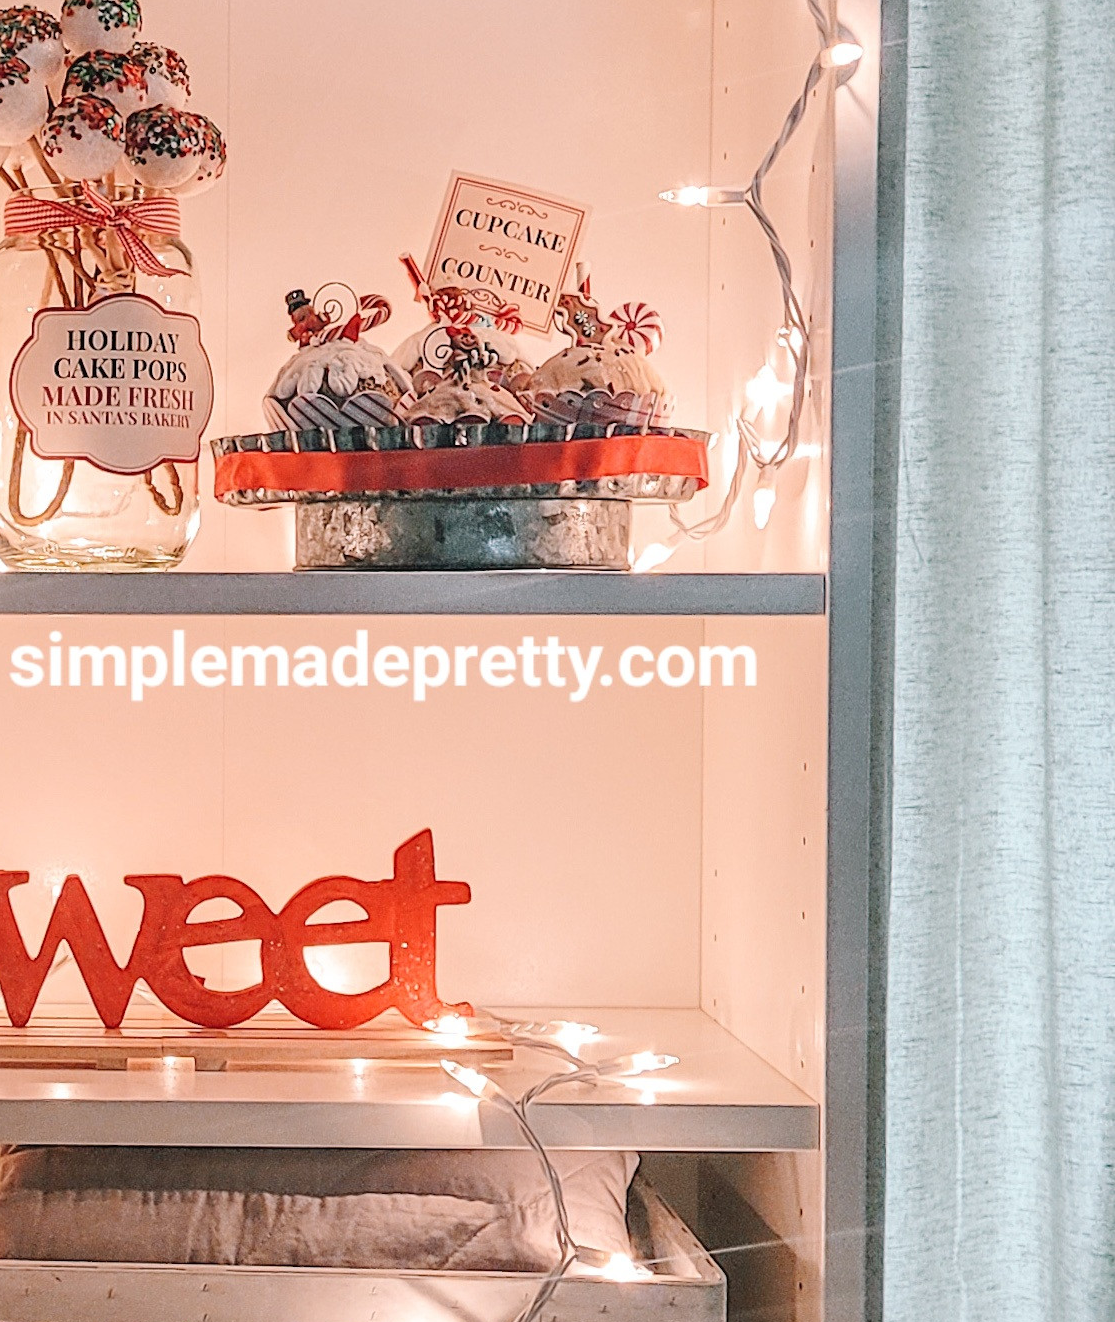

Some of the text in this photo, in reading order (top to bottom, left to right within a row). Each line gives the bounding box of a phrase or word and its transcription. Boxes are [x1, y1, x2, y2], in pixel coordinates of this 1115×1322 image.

[456, 209, 566, 253] CUPCAKE
[441, 257, 551, 303] COUNTER
[67, 330, 179, 354] HOLIDAY
[54, 357, 187, 382] CAKE POPS
[42, 386, 194, 411] MADE FRESH
[46, 411, 191, 429] IN SANTA'S BAKERY
